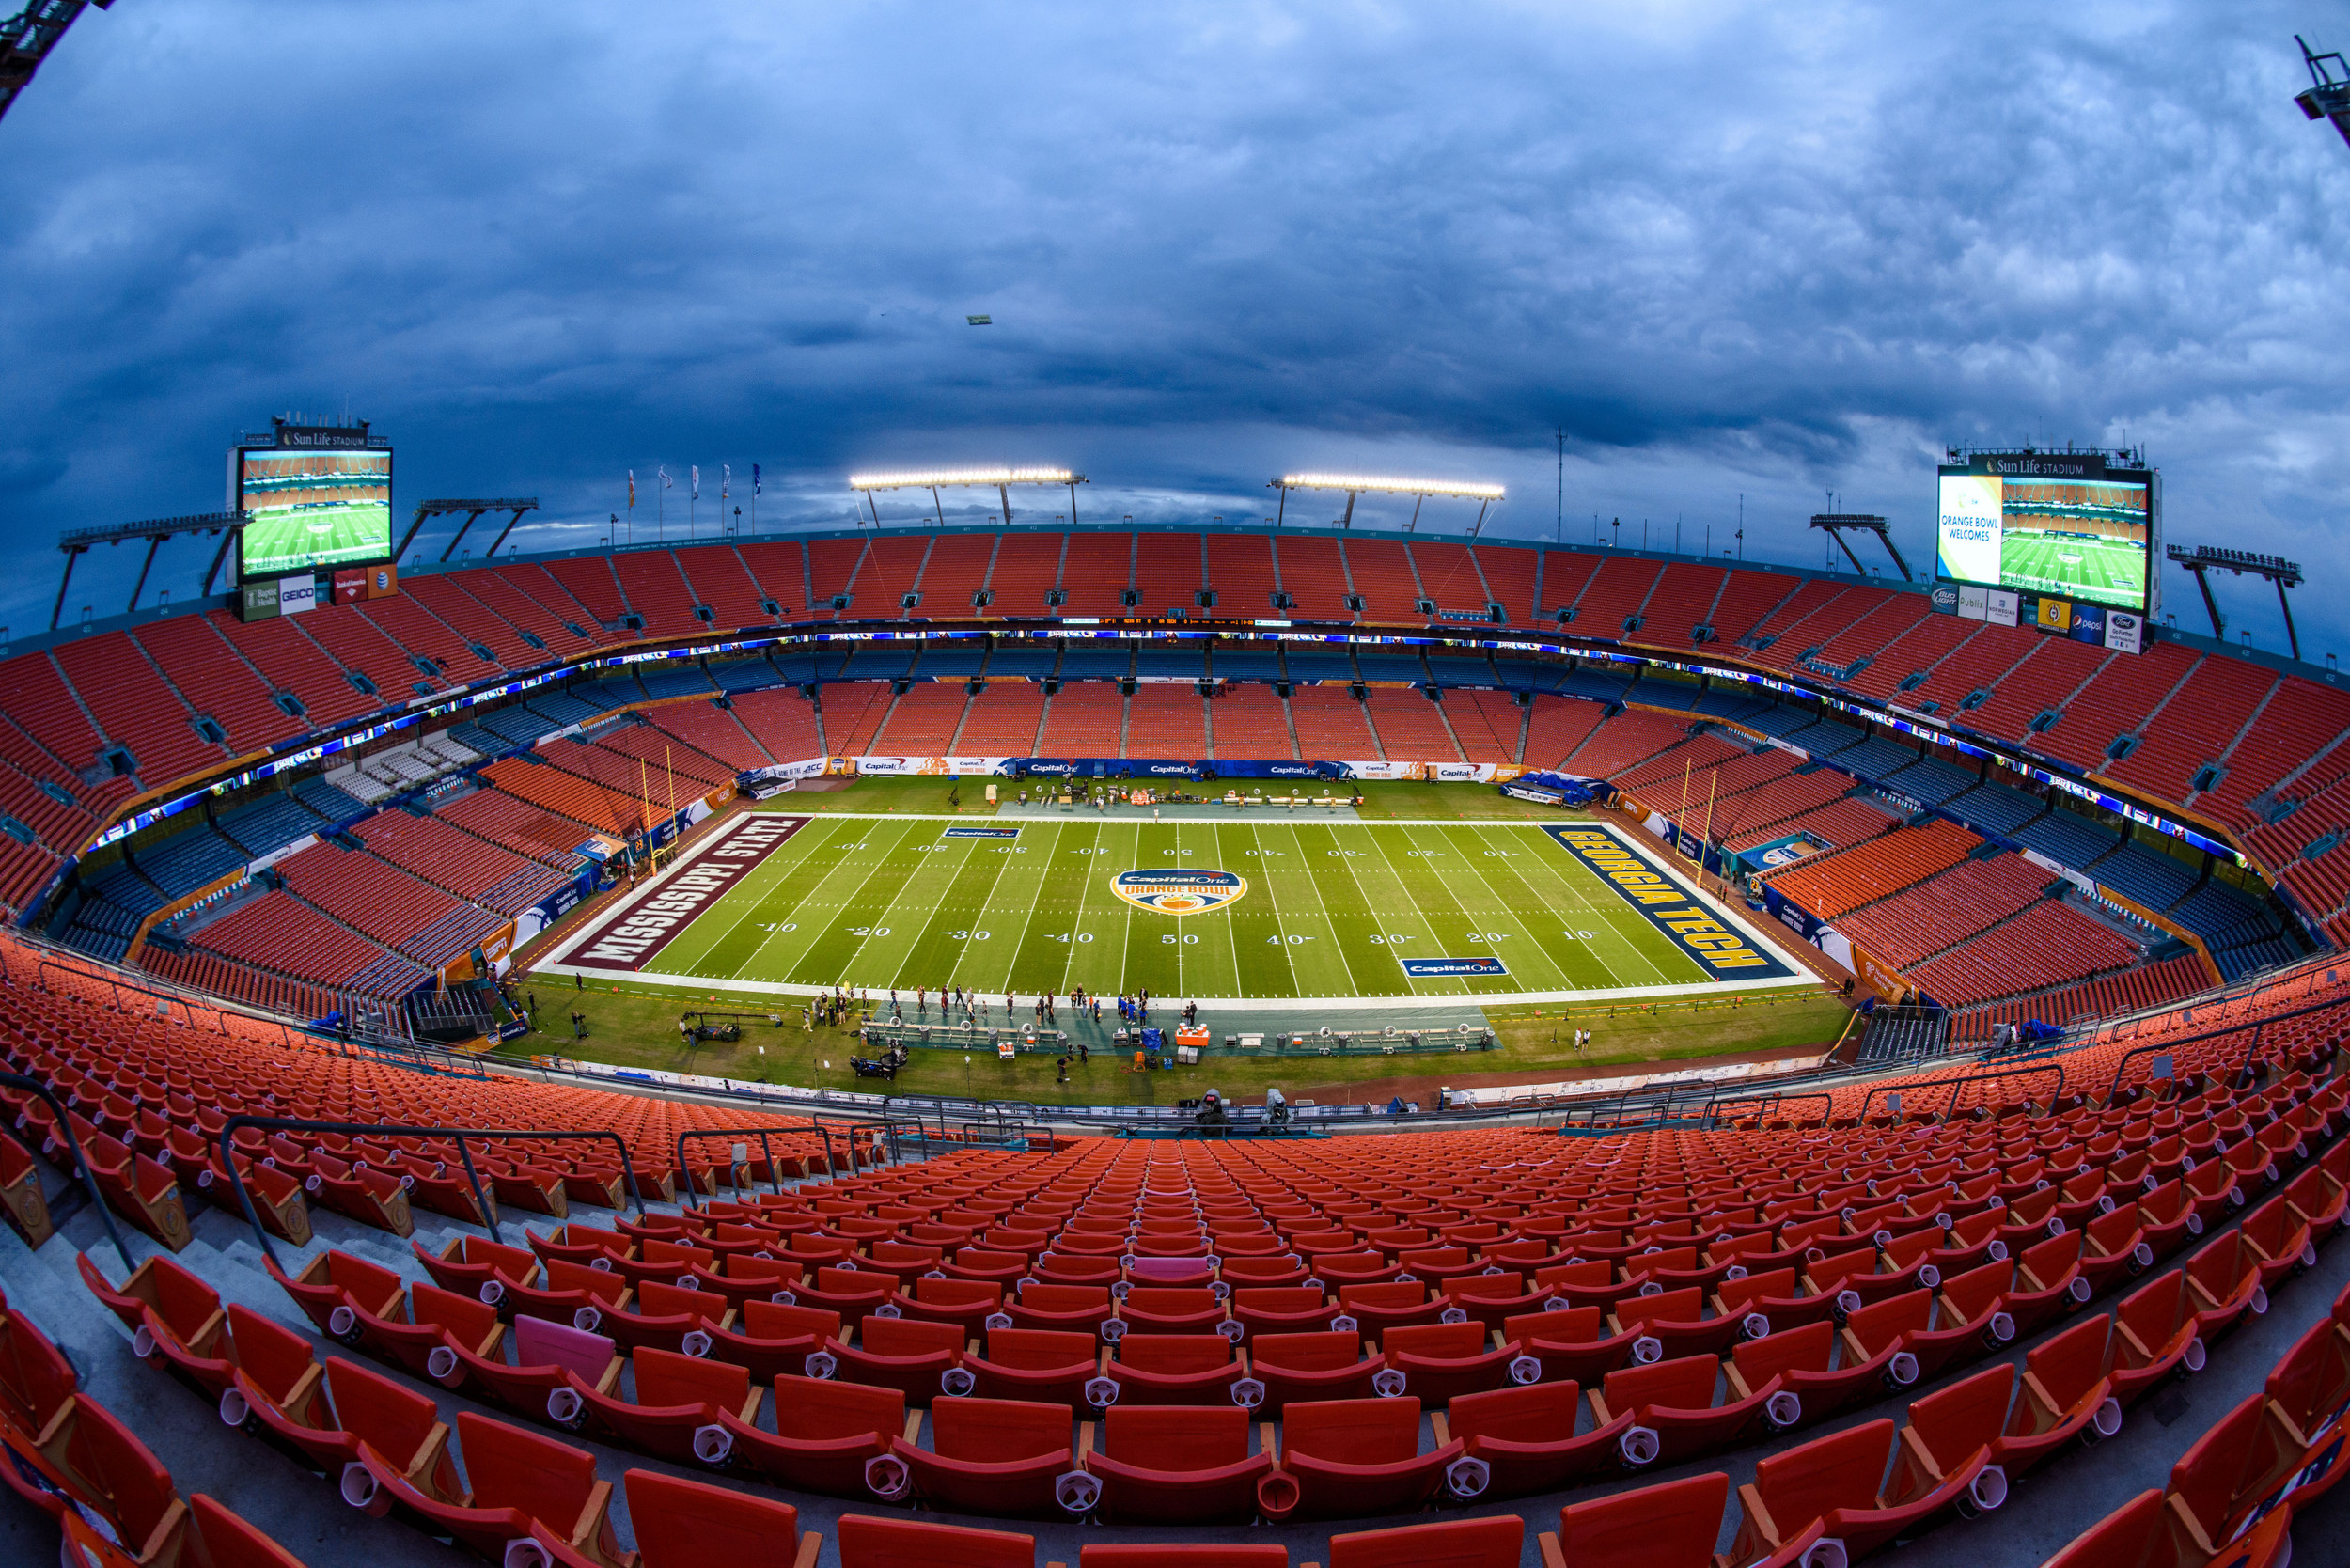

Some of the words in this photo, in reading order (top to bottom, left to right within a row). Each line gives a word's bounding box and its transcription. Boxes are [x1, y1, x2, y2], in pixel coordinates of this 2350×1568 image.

[293, 433, 312, 445] Sun
[313, 432, 331, 446] Life
[333, 436, 365, 446] STADIUM
[1998, 460, 2018, 474] Sun
[2020, 459, 2041, 474] Life
[2043, 464, 2084, 475] STADIUM
[1941, 514, 1973, 528] ORANGE
[1975, 516, 1998, 529] BOWL
[1949, 528, 1990, 542] WELCOMES
[282, 588, 314, 602] GEICO
[1935, 596, 1957, 605] LIGHT
[1960, 597, 1983, 609] Publix
[1989, 606, 2015, 616] NORWEGIAN
[2082, 619, 2102, 631] pepsi
[2115, 617, 2131, 627] Ford
[804, 762, 822, 773] ACC
[580, 862, 744, 963] MISSISSIPPI
[713, 820, 797, 858] STATE
[1124, 885, 1185, 896] ORANGE
[1188, 886, 1233, 897] BOWL
[1559, 830, 1688, 905] GEORGIA
[1654, 907, 1770, 969] TECH
[763, 922, 798, 933] 10
[854, 926, 891, 937] 20
[952, 929, 991, 941] 30
[1056, 933, 1094, 944] 40
[1161, 933, 1199, 945] 50
[1266, 933, 1305, 945] 40
[1369, 933, 1406, 944] 30
[1466, 932, 1503, 944] 20
[1562, 930, 1596, 941] 10
